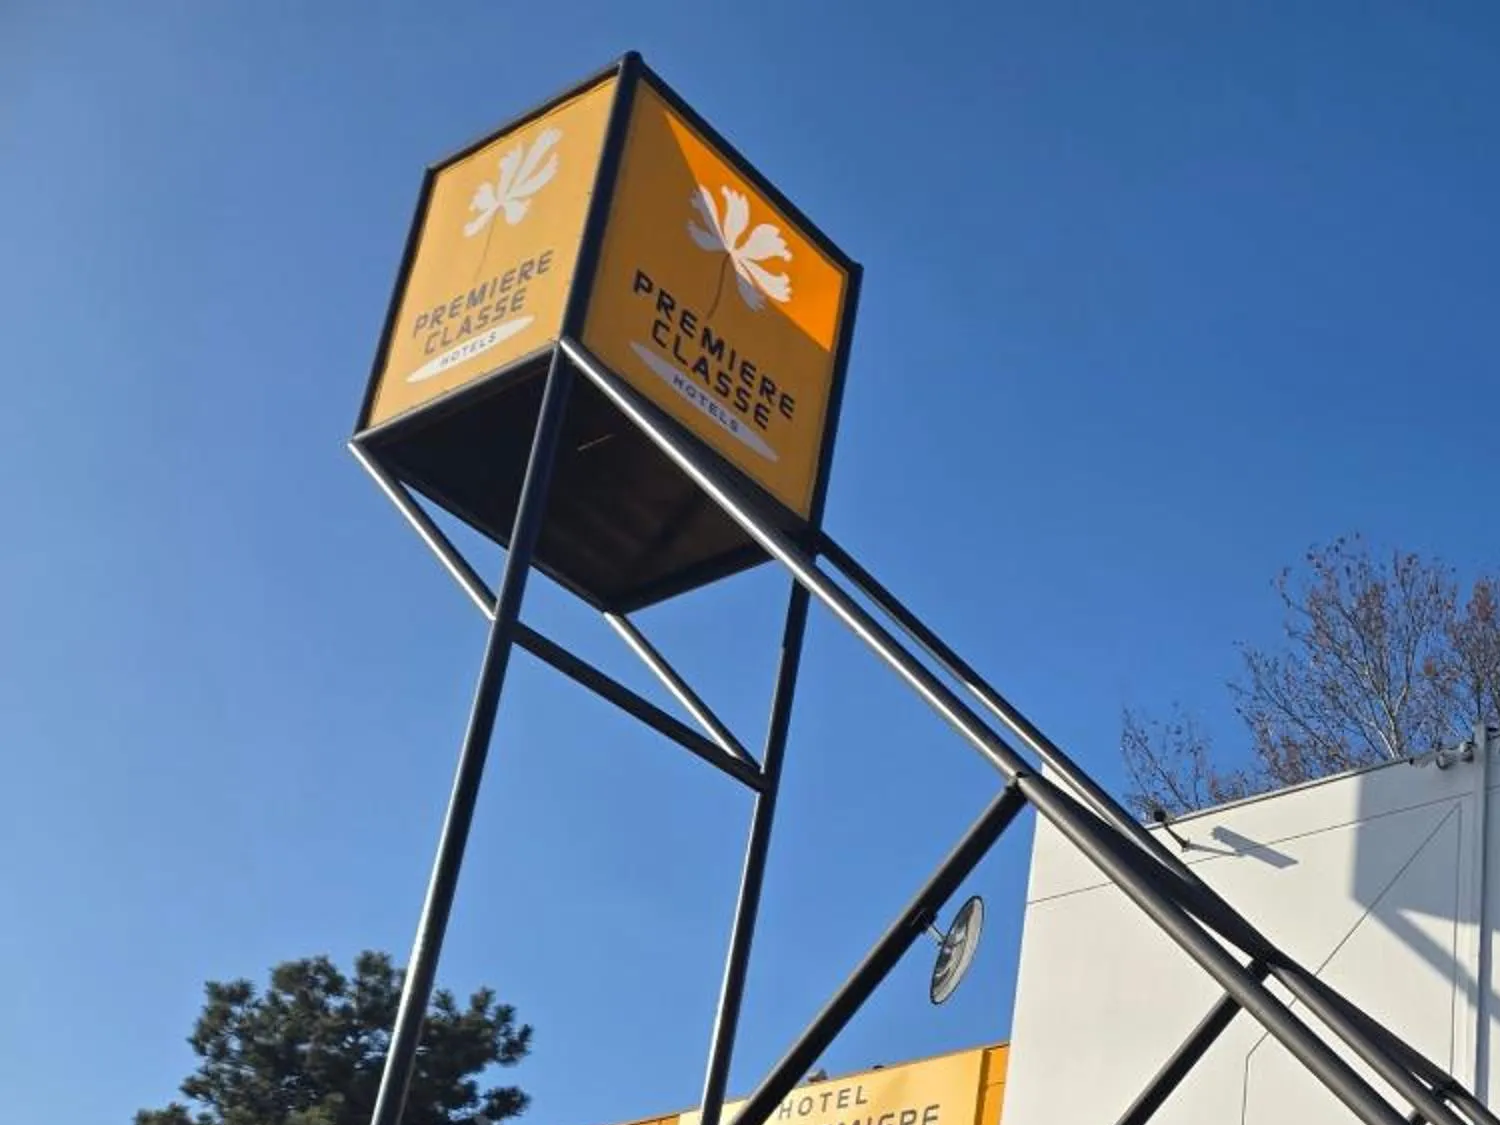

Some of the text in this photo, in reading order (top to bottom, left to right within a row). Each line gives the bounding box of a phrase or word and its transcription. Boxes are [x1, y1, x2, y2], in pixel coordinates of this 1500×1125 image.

[412, 250, 554, 340] PREMIERE
[423, 288, 528, 355] CLASSE
[440, 331, 498, 367] HOTELS
[633, 270, 797, 420] PREMIERE
[651, 319, 770, 431] CLASSE
[673, 374, 741, 433] HOTELS
[777, 1085, 869, 1121] HOTEL
